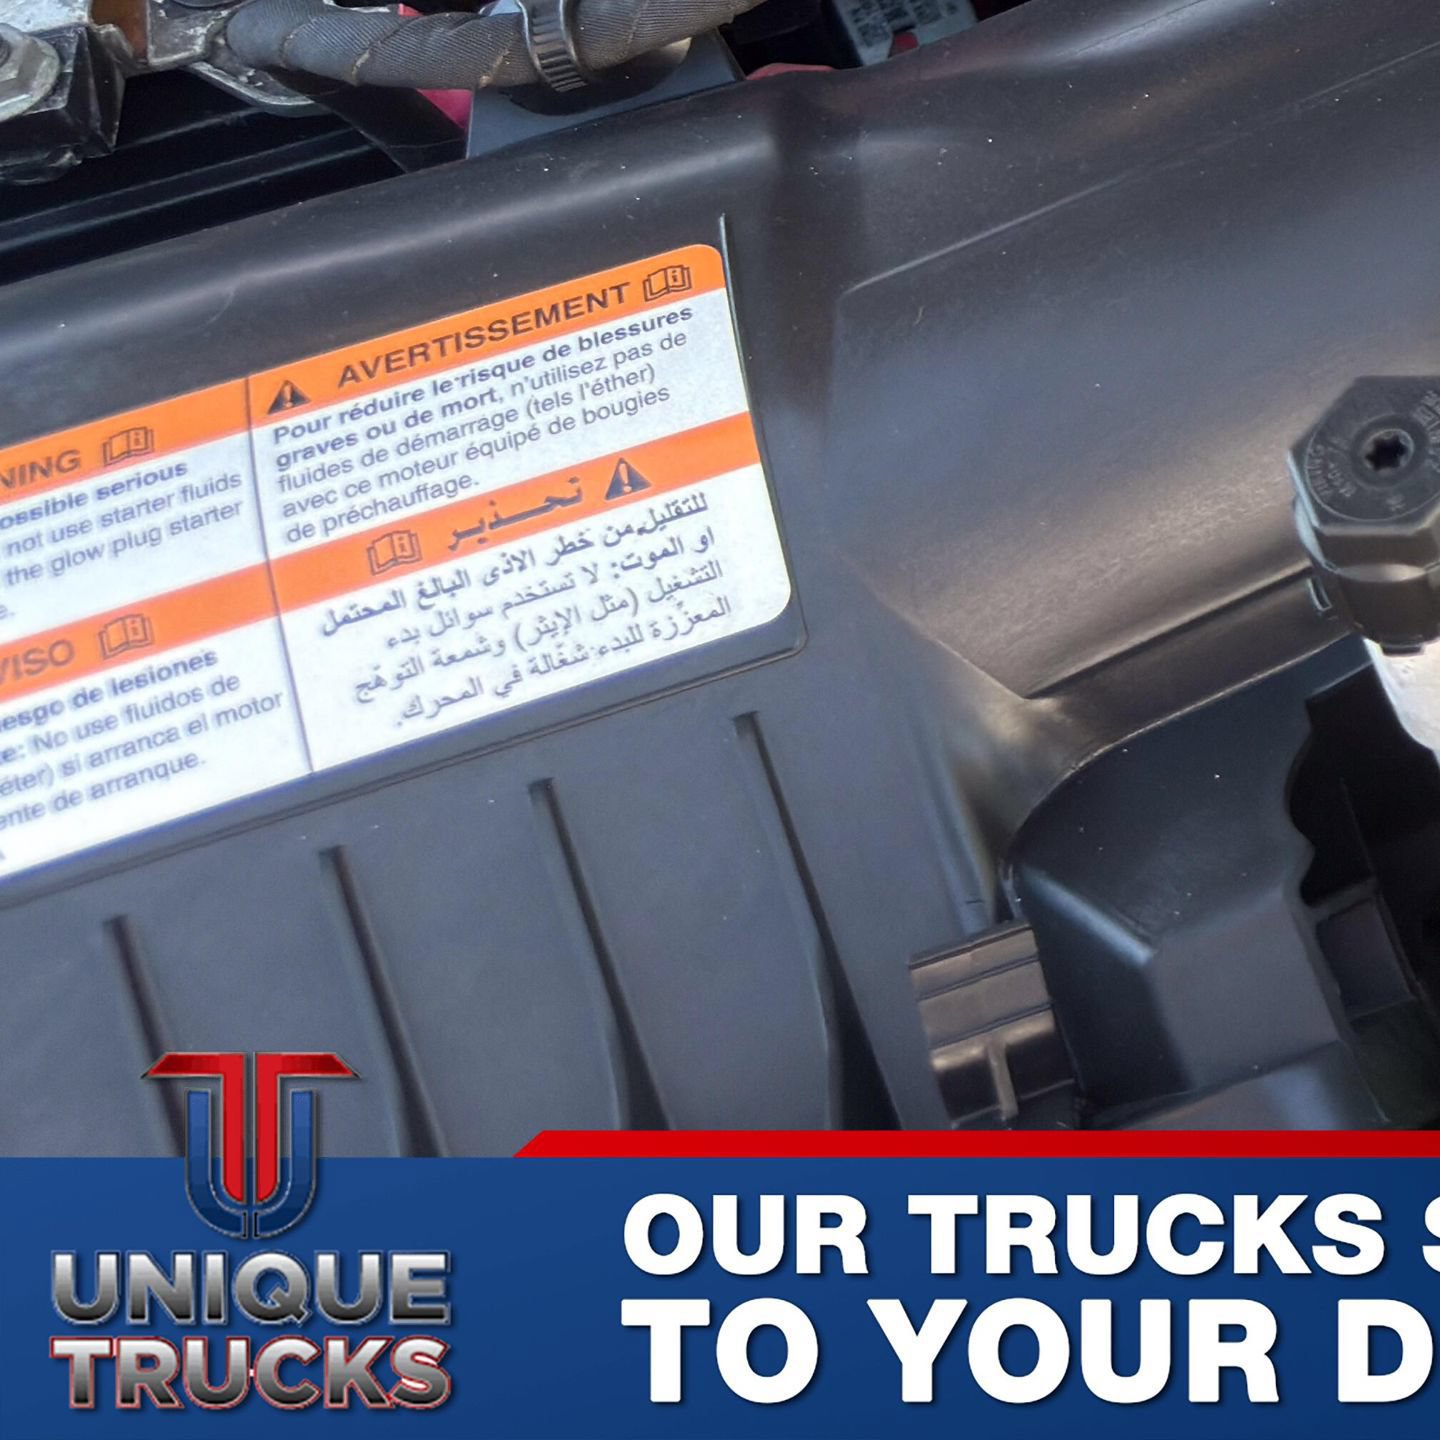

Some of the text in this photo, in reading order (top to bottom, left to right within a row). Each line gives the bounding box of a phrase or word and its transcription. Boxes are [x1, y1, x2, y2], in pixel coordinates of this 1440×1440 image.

[273, 308, 692, 445] Pour réduire le risque de blessures
[338, 282, 630, 388] AVERTISSEMENT
[276, 333, 686, 472] graves ou de mort, n'utilisez pas de
[277, 363, 655, 492] fluides de démarrage (tels l'éther)
[96, 463, 187, 500] serious
[282, 388, 670, 518] avec ce moteur équipé de bougies
[4, 502, 241, 586] the glow plug starter
[6, 474, 241, 556] not use starter fluids
[286, 475, 479, 543] de préchauffage.
[30, 731, 68, 753] No
[75, 715, 118, 740] use
[123, 687, 203, 723] fluidos
[210, 676, 239, 696] de
[72, 688, 102, 708] de
[111, 652, 217, 696] lesiones
[60, 759, 81, 777] si
[88, 727, 180, 768] arranca
[187, 714, 208, 735] el
[214, 693, 281, 726] motor
[52, 791, 82, 811] de
[90, 753, 206, 800] arranque.
